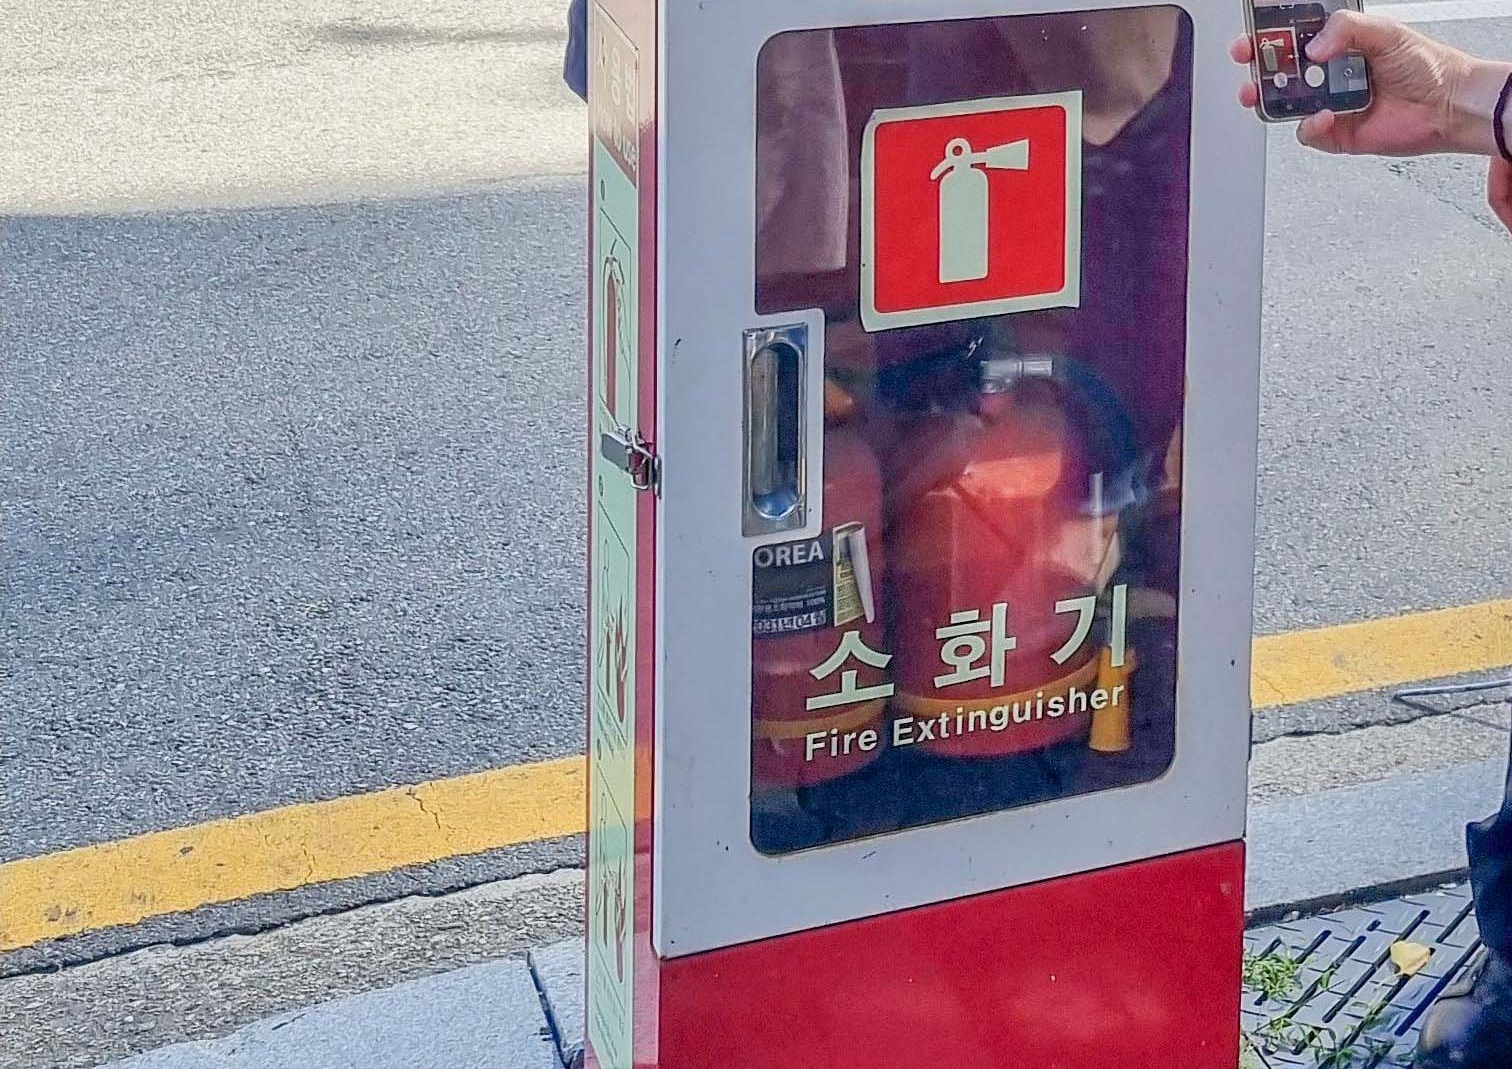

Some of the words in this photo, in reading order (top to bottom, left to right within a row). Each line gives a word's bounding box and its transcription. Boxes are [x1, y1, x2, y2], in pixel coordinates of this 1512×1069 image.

[805, 583, 1128, 712] 소화기
[805, 728, 878, 762] Fire
[893, 684, 1125, 747] Extinguisher
